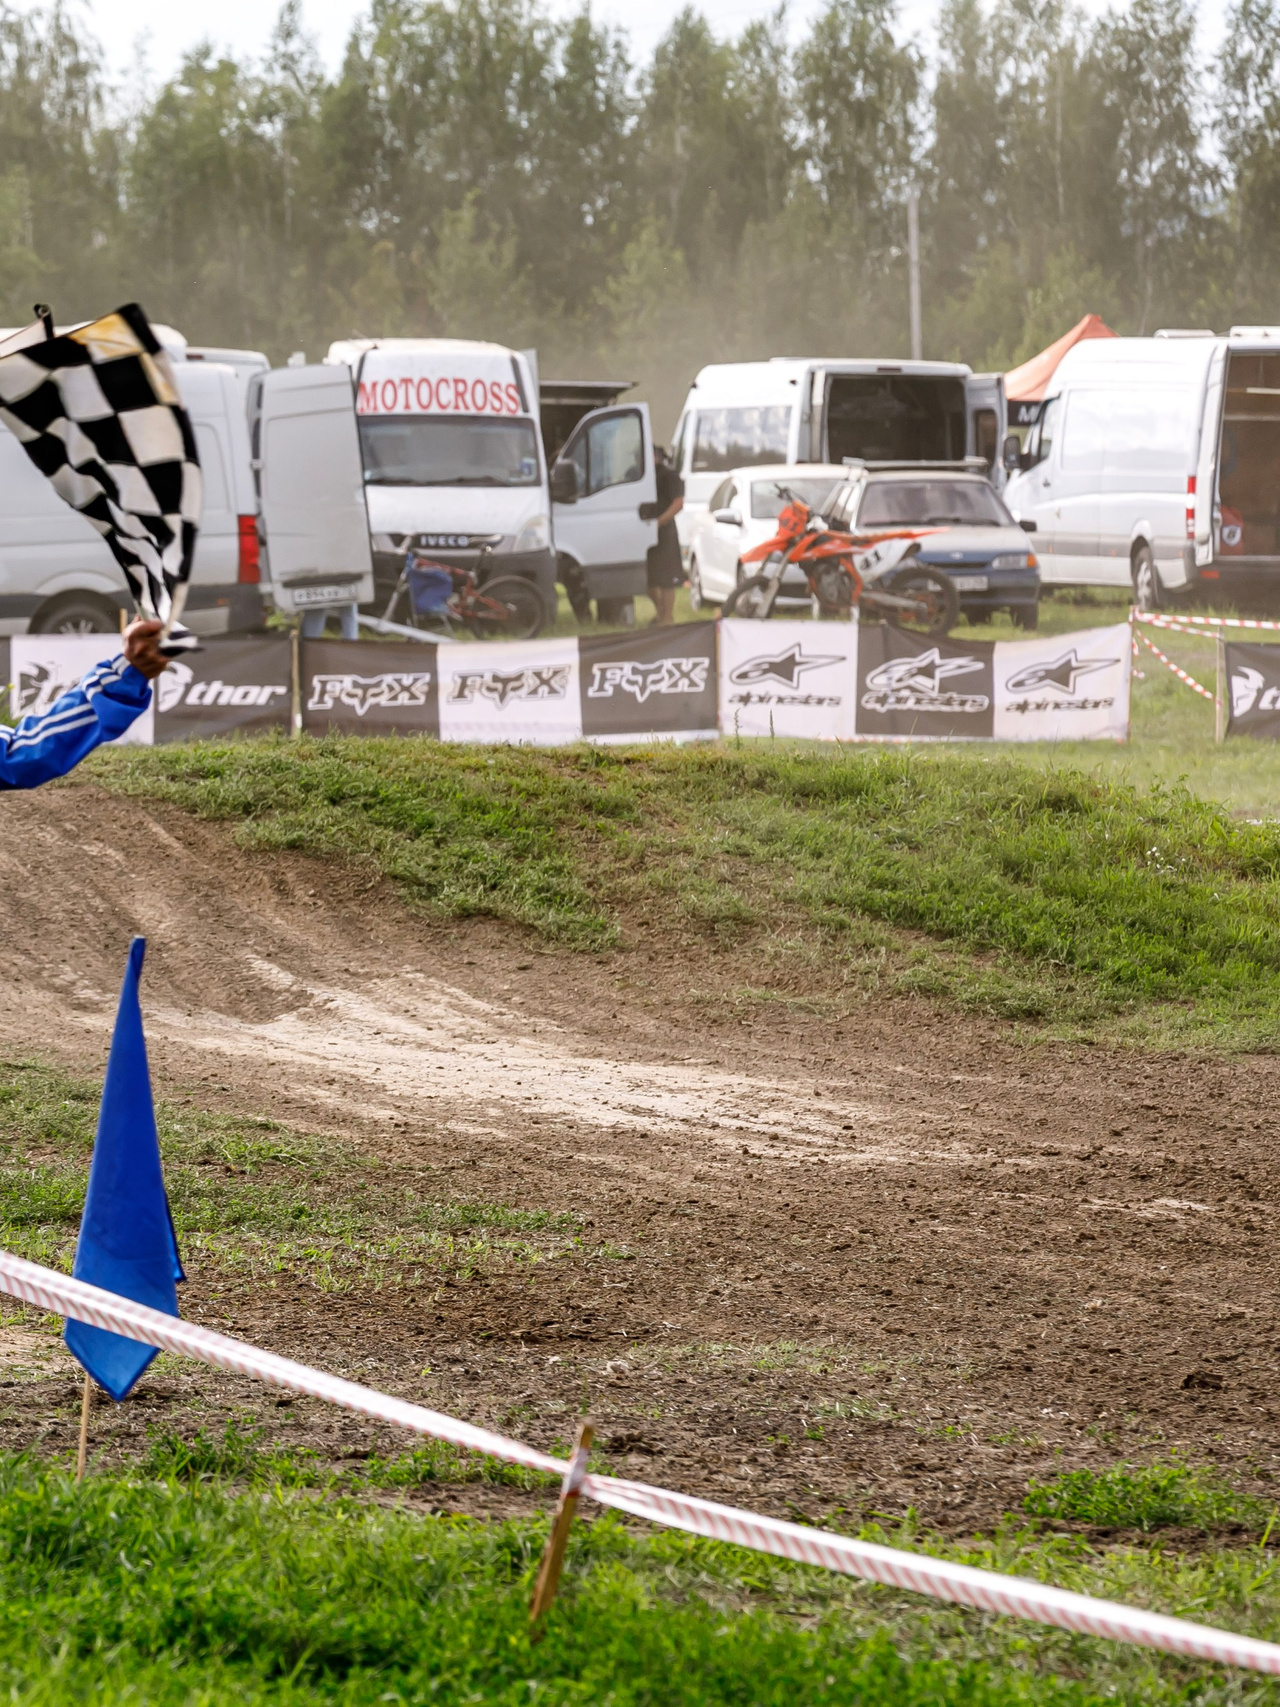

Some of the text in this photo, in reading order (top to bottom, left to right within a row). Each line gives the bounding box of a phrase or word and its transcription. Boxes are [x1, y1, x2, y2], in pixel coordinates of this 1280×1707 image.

[358, 377, 521, 416] MOTOCROSS
[421, 535, 469, 547] IVECO
[860, 550, 884, 571] 41
[185, 680, 288, 706] thor
